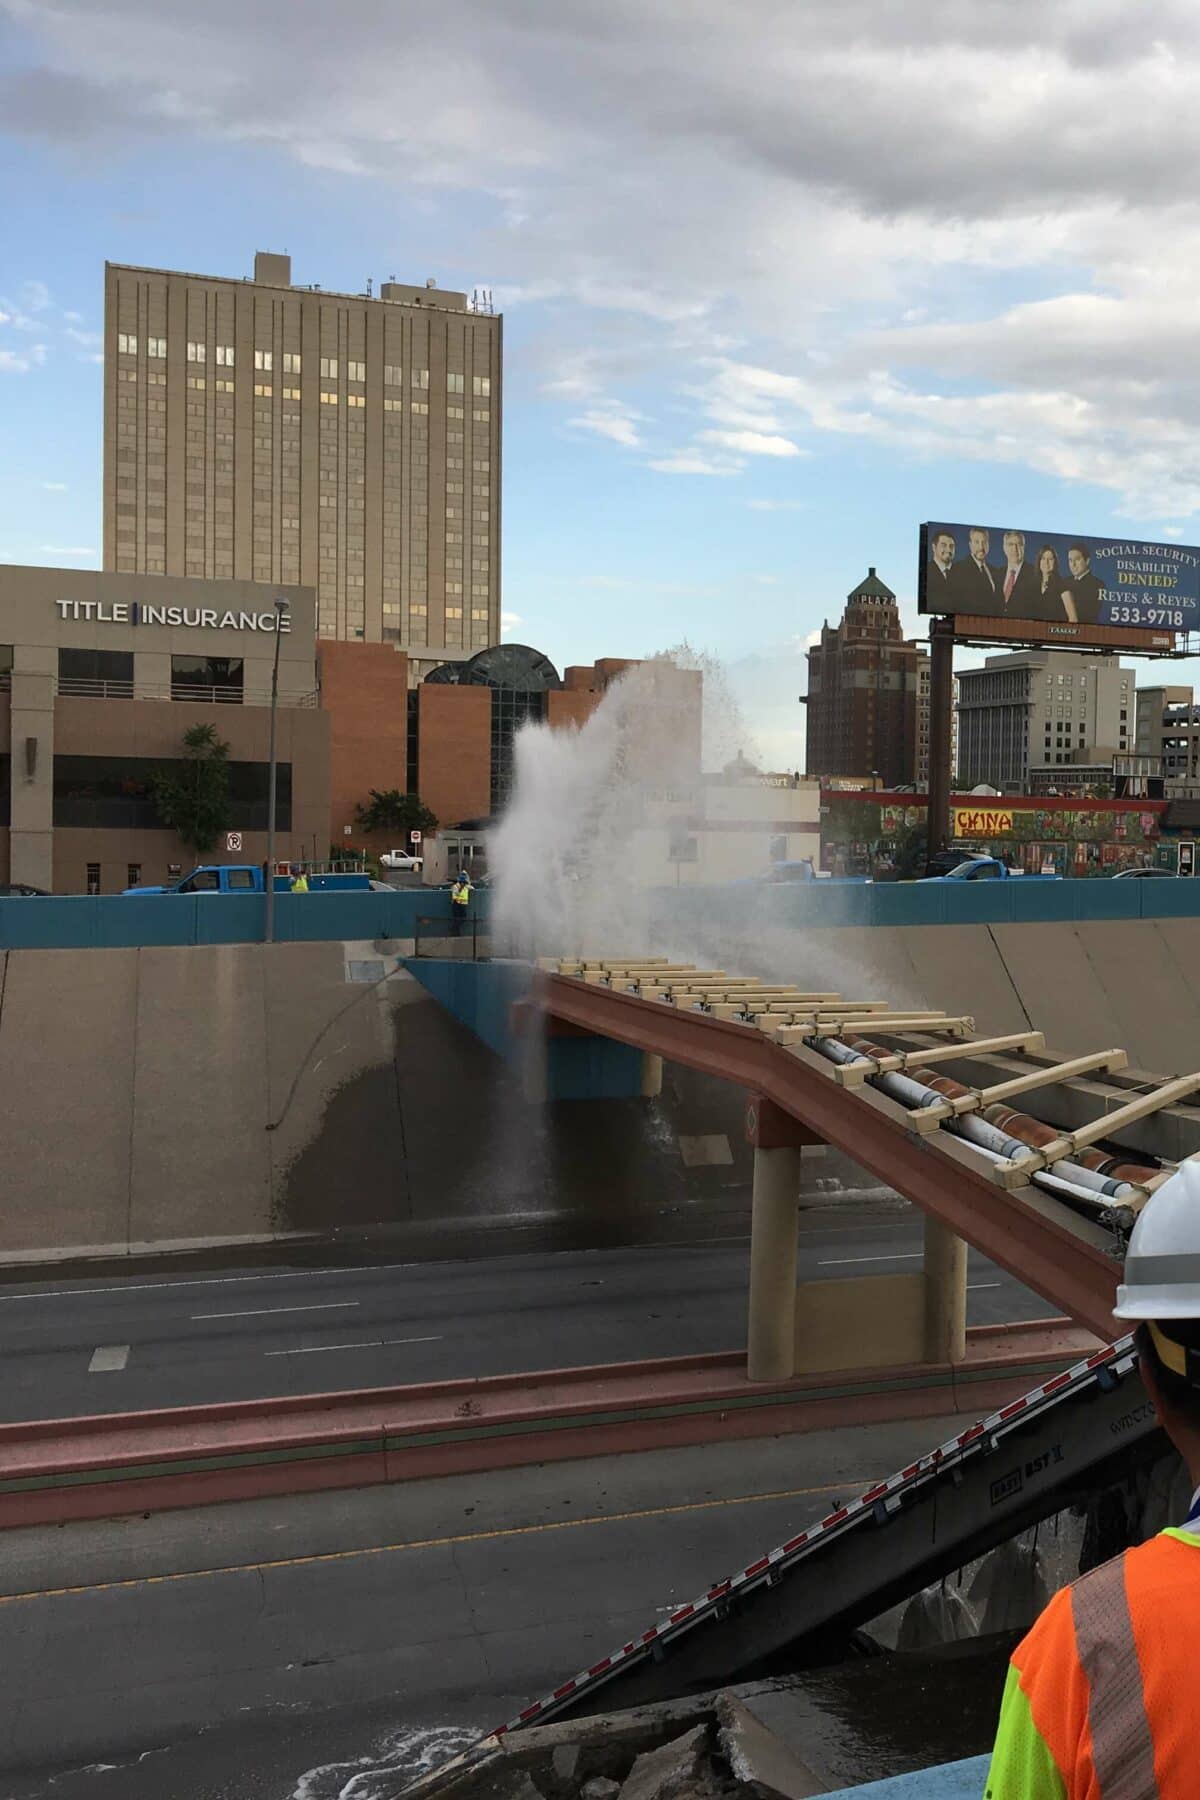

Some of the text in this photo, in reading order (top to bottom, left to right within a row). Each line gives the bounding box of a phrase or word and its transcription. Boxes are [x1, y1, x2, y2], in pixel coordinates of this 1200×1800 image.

[1096, 545, 1200, 567] SOCIAL SECURITY
[1117, 560, 1179, 574] DISABILITY
[1119, 572, 1178, 588] DENIED?
[1141, 592, 1153, 604] &
[56, 600, 291, 633] TITLE INSURANCE
[1110, 606, 1183, 626] 533-9718
[957, 812, 1012, 829] CHINA
